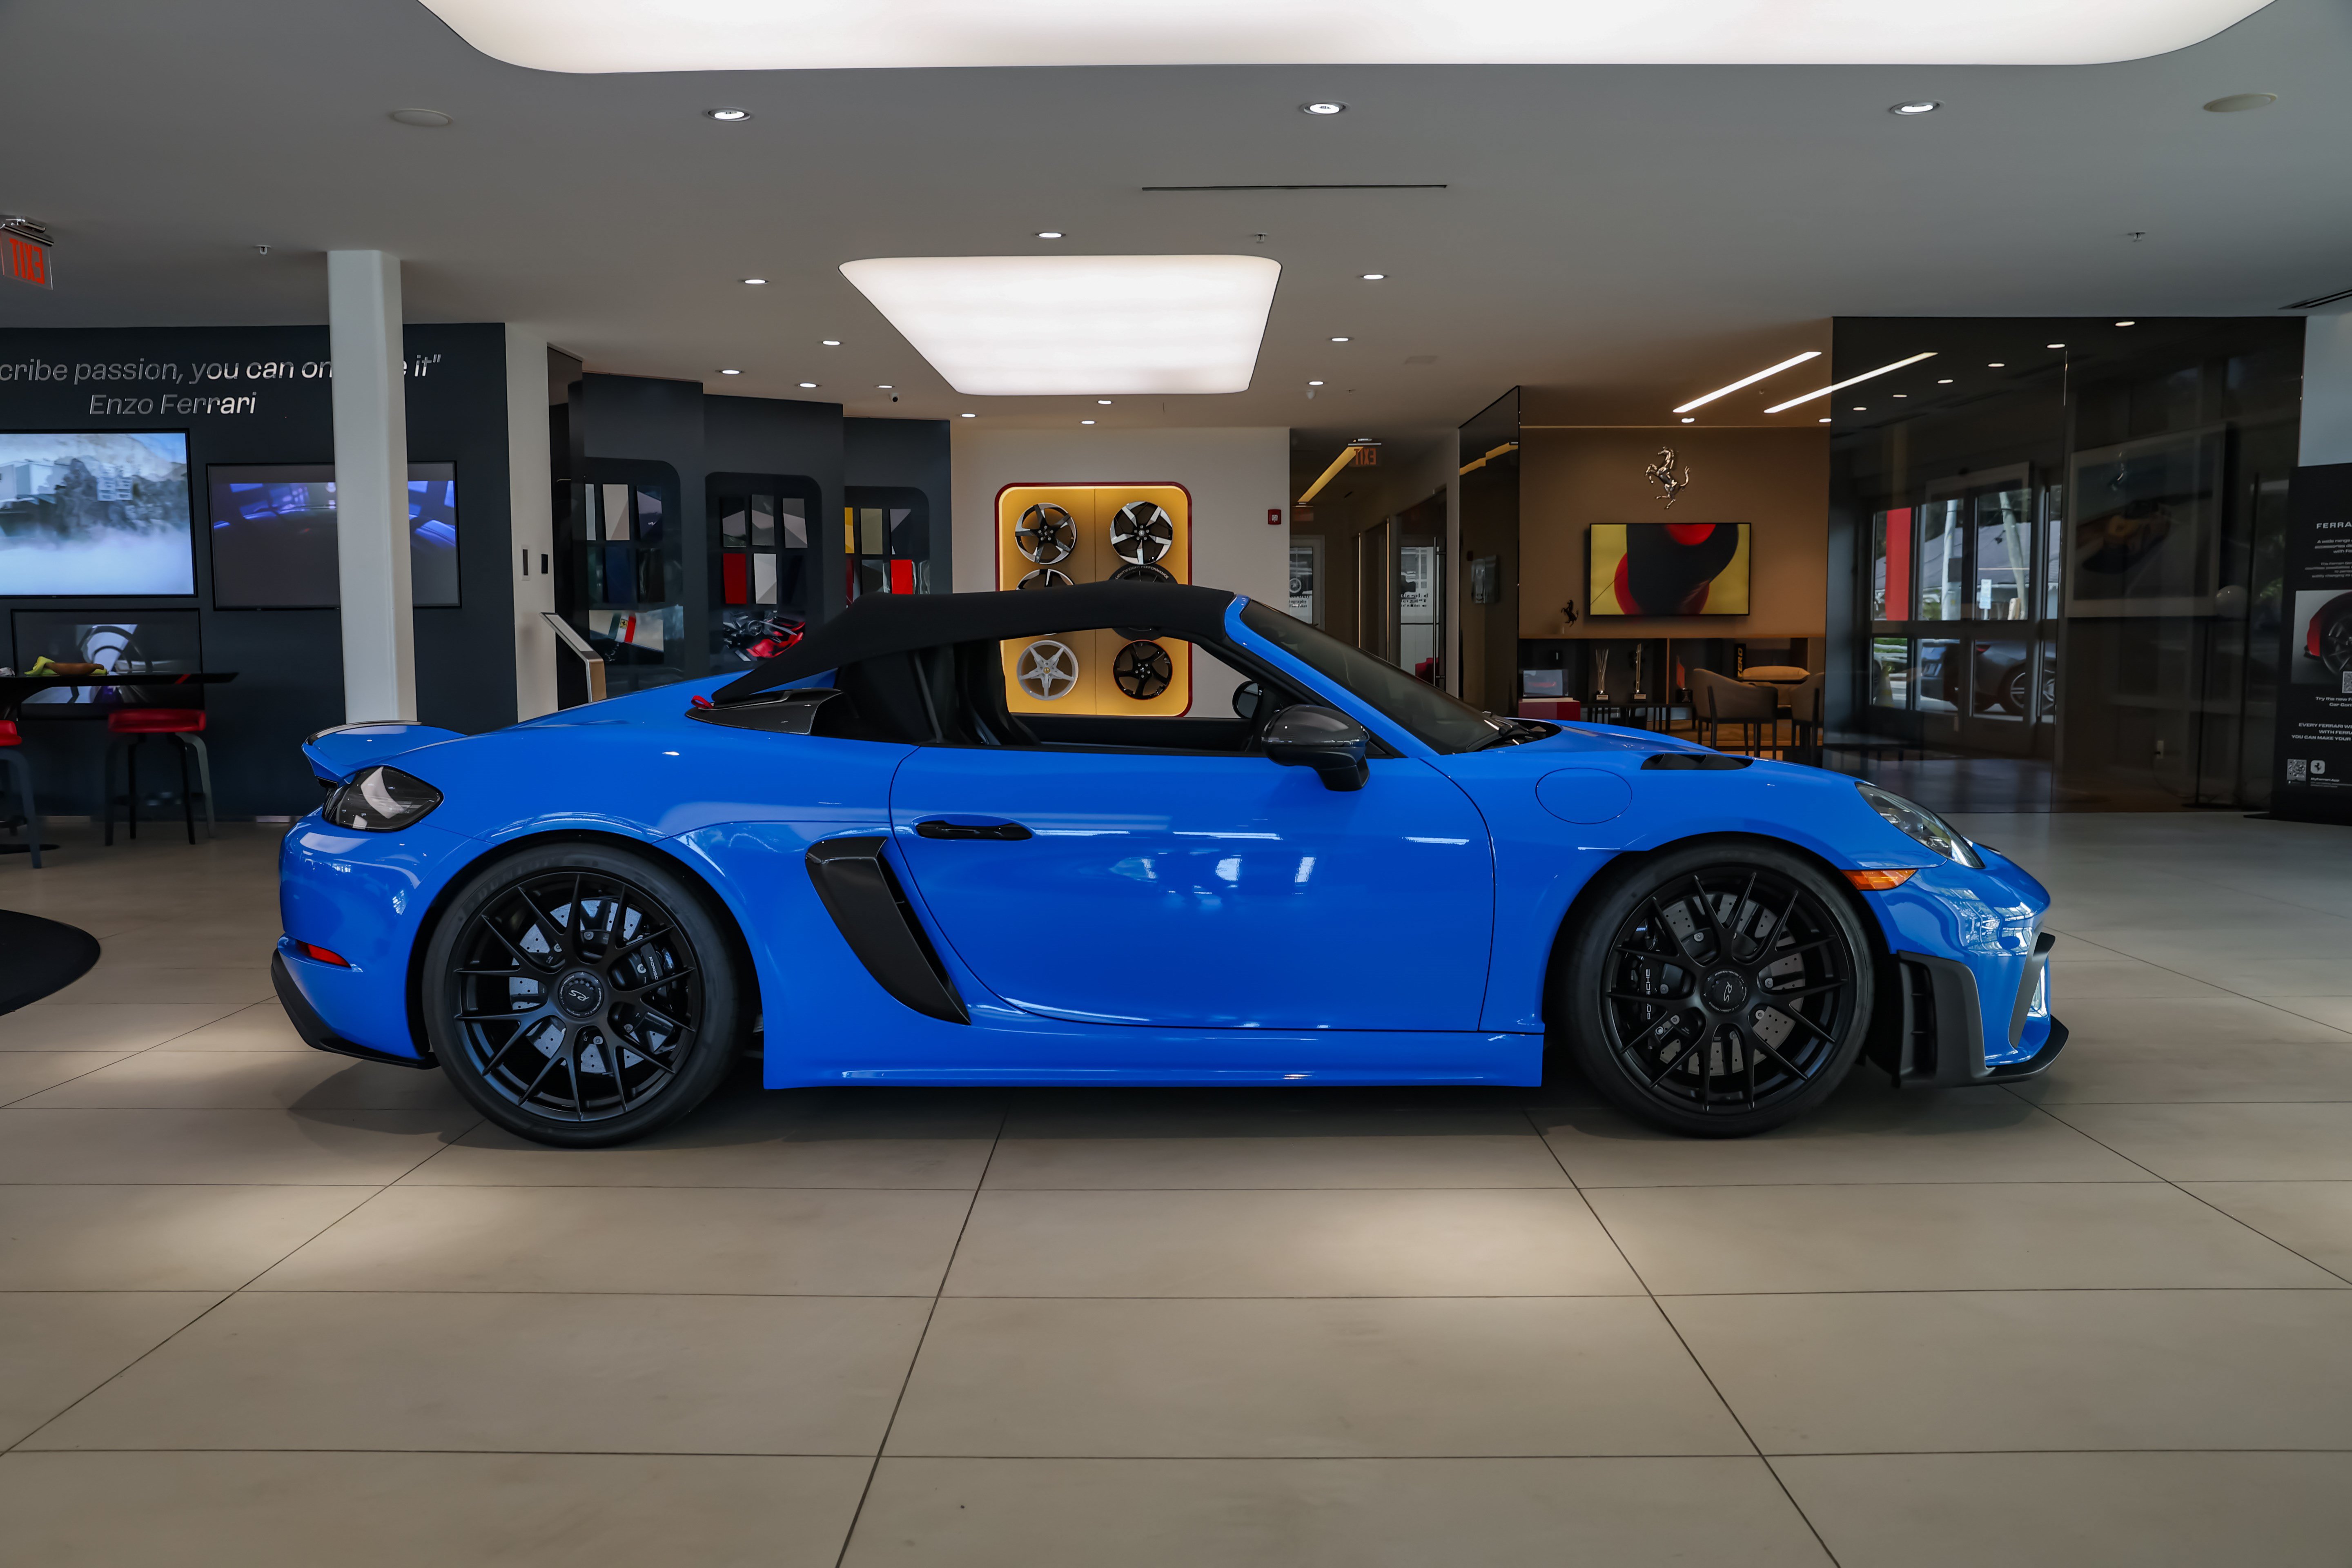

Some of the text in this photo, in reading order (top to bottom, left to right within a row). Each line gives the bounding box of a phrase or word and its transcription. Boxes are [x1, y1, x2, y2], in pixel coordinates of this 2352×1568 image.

[74, 358, 184, 385] passion,
[189, 363, 239, 385] you
[246, 361, 294, 380] can
[89, 392, 257, 415] Enzo Ferrari
[1140, 565, 1169, 579] PERFORMANCE
[649, 956, 659, 980] PORSC
[568, 989, 590, 1002] RS
[1723, 982, 1733, 1002] RS
